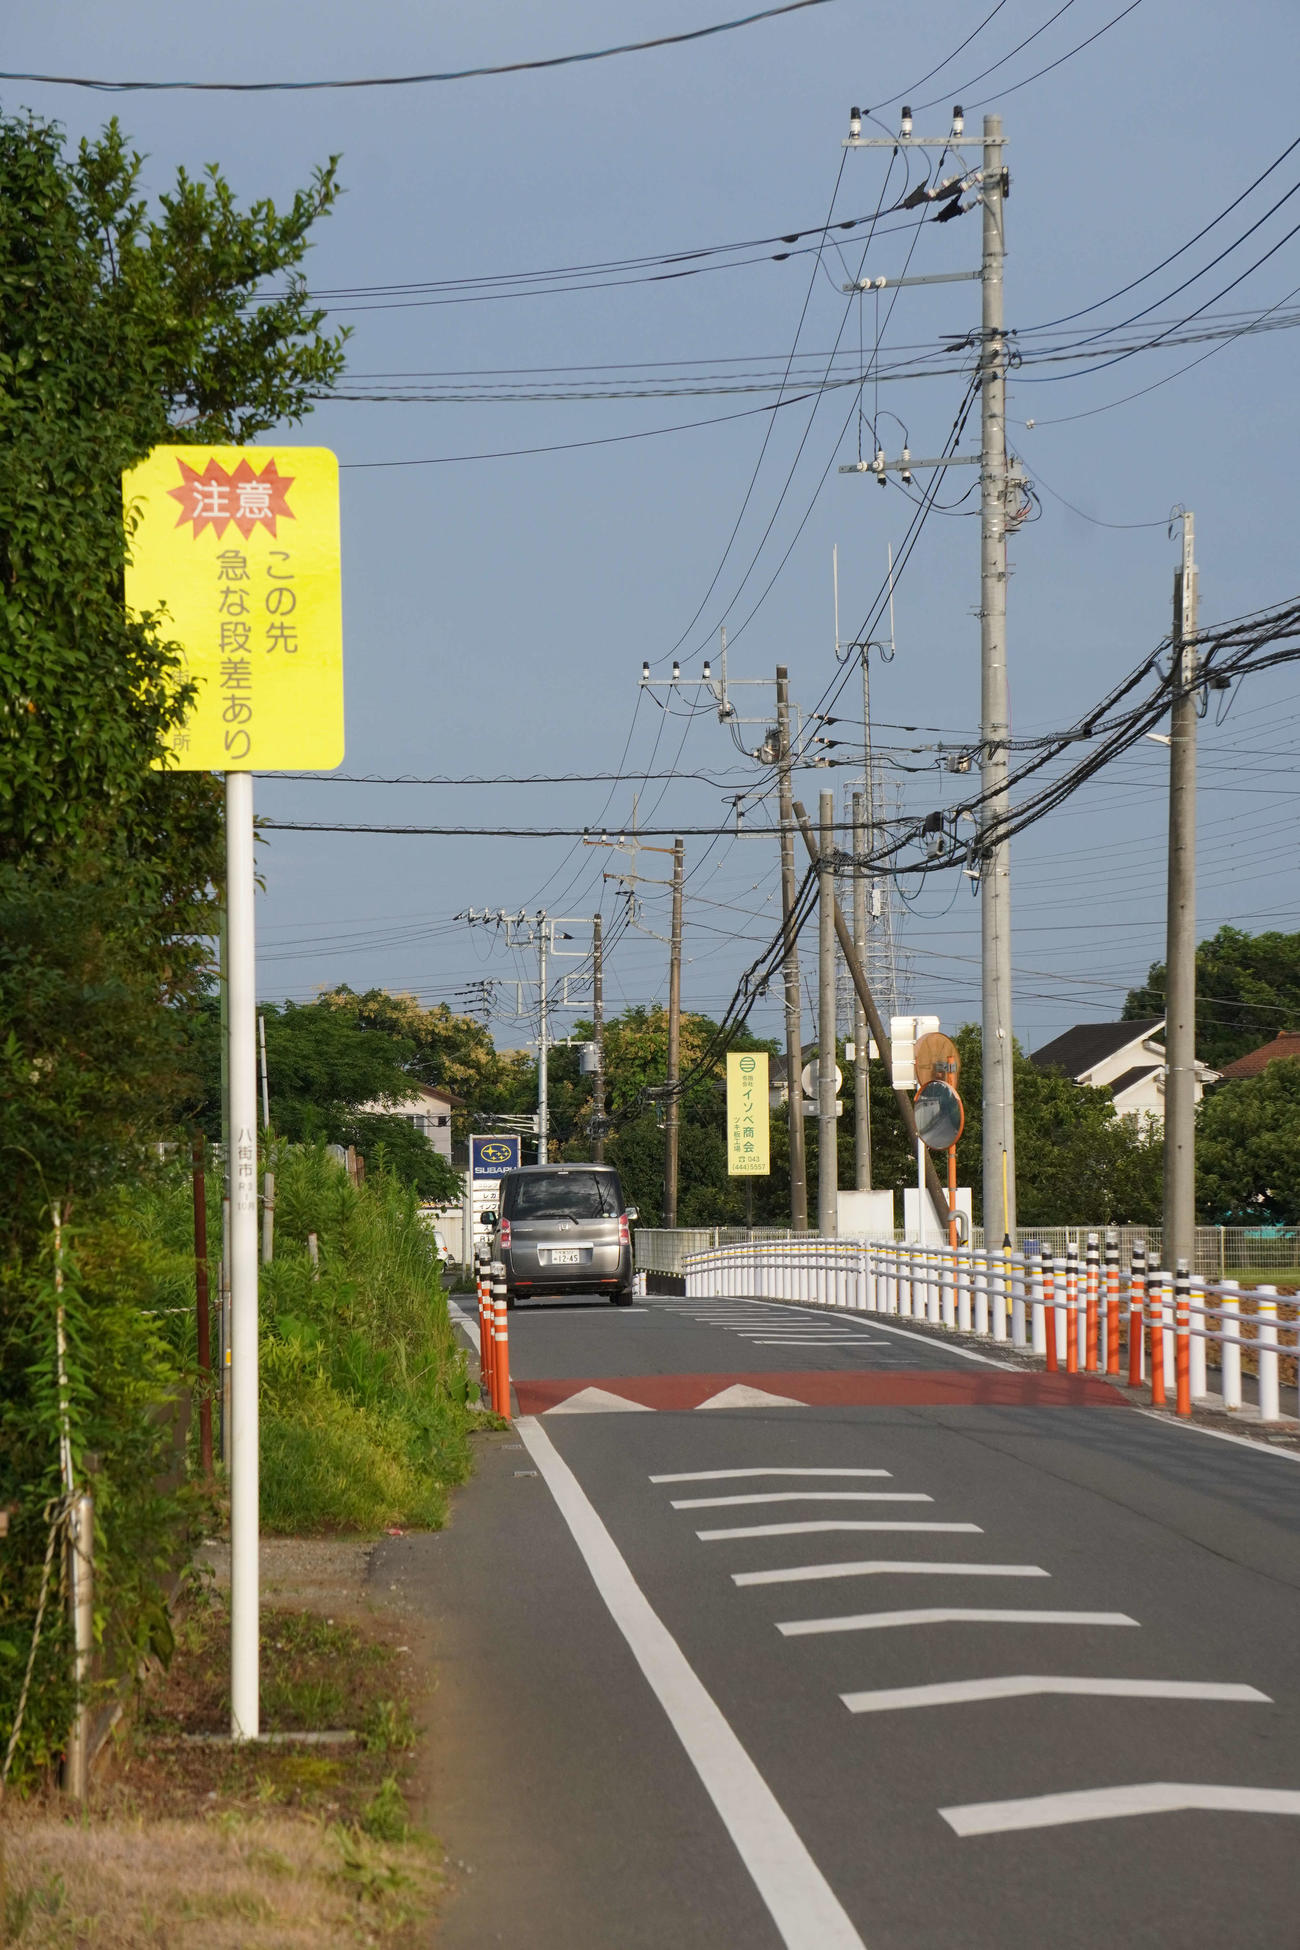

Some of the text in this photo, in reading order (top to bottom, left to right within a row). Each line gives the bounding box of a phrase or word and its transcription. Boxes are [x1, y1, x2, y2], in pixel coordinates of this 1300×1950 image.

[192, 480, 273, 519] 注意
[265, 550, 298, 654] この先
[216, 549, 253, 760] 急な段差あり
[238, 1128, 253, 1177] 八街市
